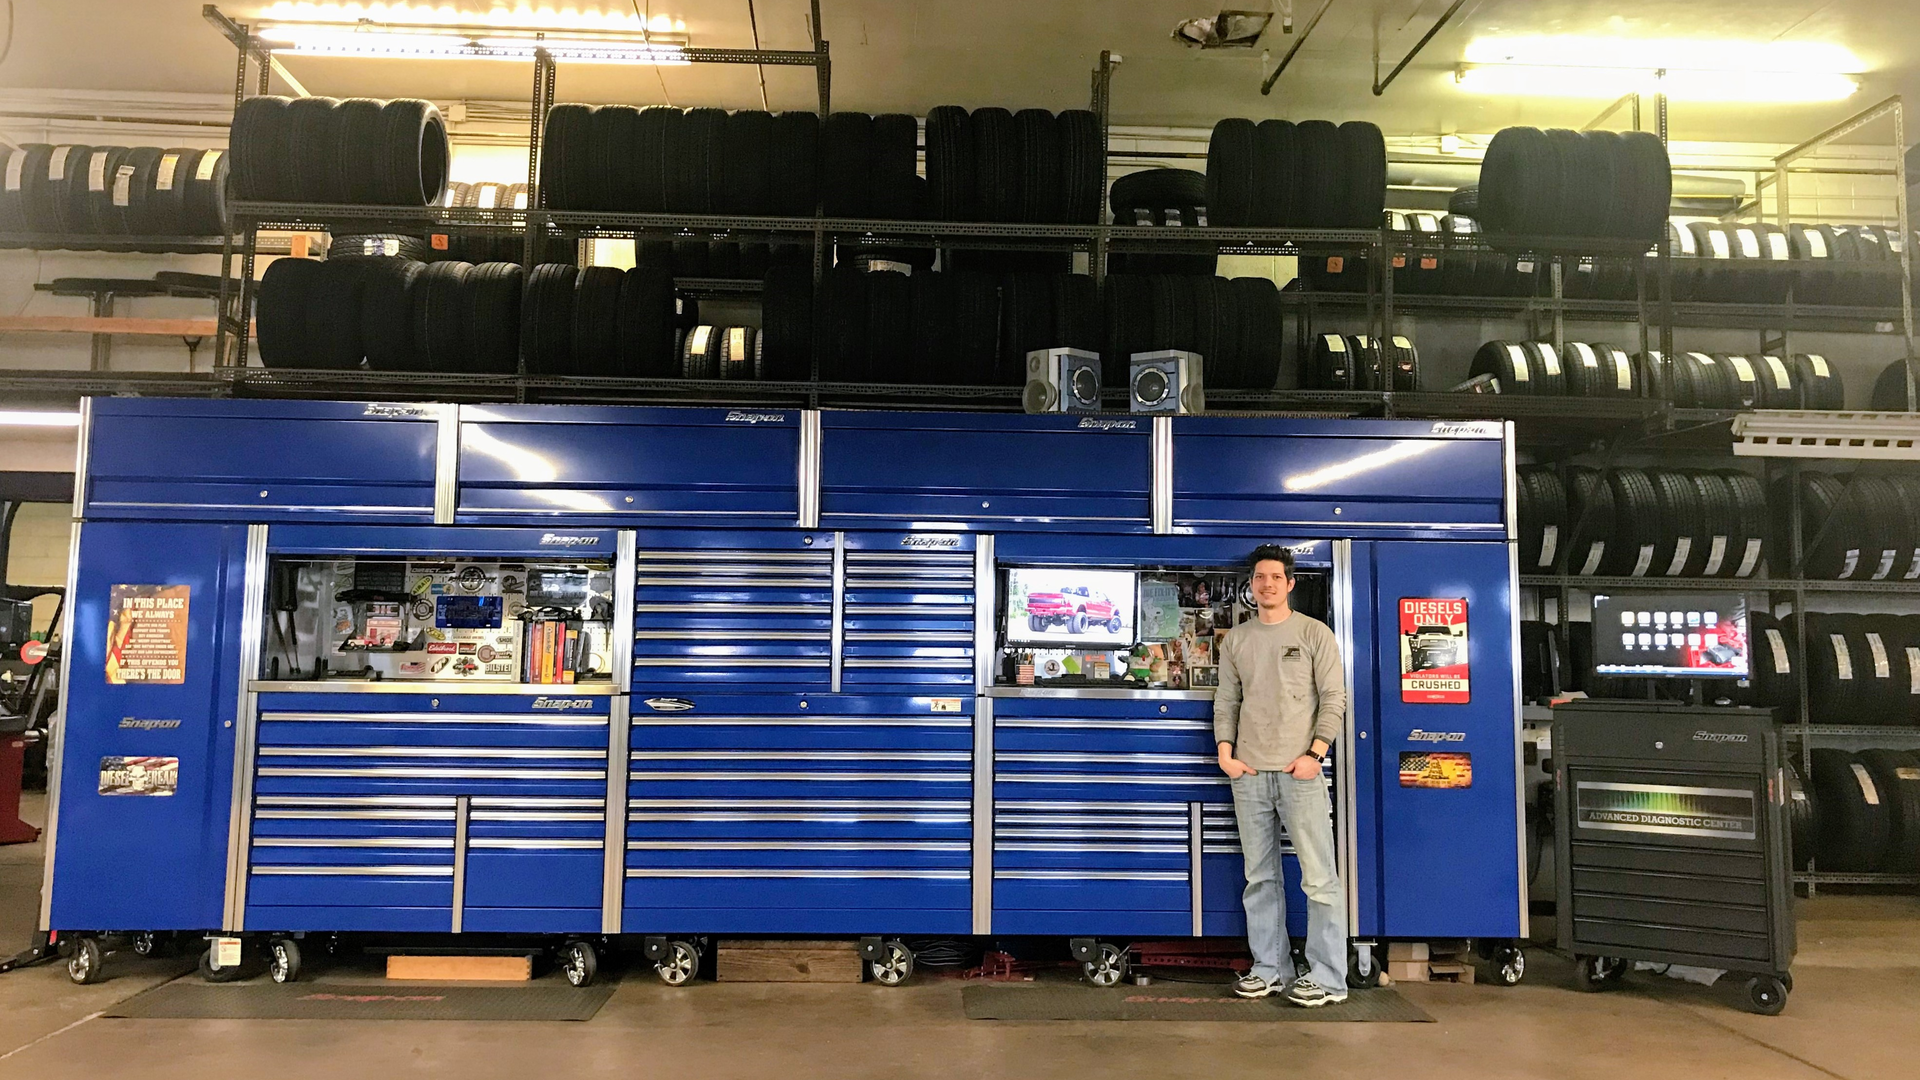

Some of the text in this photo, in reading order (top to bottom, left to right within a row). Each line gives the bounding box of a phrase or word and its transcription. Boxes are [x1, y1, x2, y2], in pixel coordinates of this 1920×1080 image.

[539, 533, 599, 547] Snap-on
[123, 598, 184, 609] IN THIS PLACE
[1404, 601, 1463, 615] DIESELS
[131, 610, 175, 619] WE ALWAYS
[1413, 613, 1454, 626] ONLY
[116, 668, 181, 680] THERE'S THE DOOR
[1411, 680, 1461, 690] CRUSHED
[531, 696, 593, 711] Snap-on
[118, 716, 181, 731] Snap-on
[1407, 728, 1467, 743] Snap-on
[1692, 730, 1749, 743] Snap-on
[1589, 811, 1743, 830] ADVANCED DIAGNOSTIC CENTER
